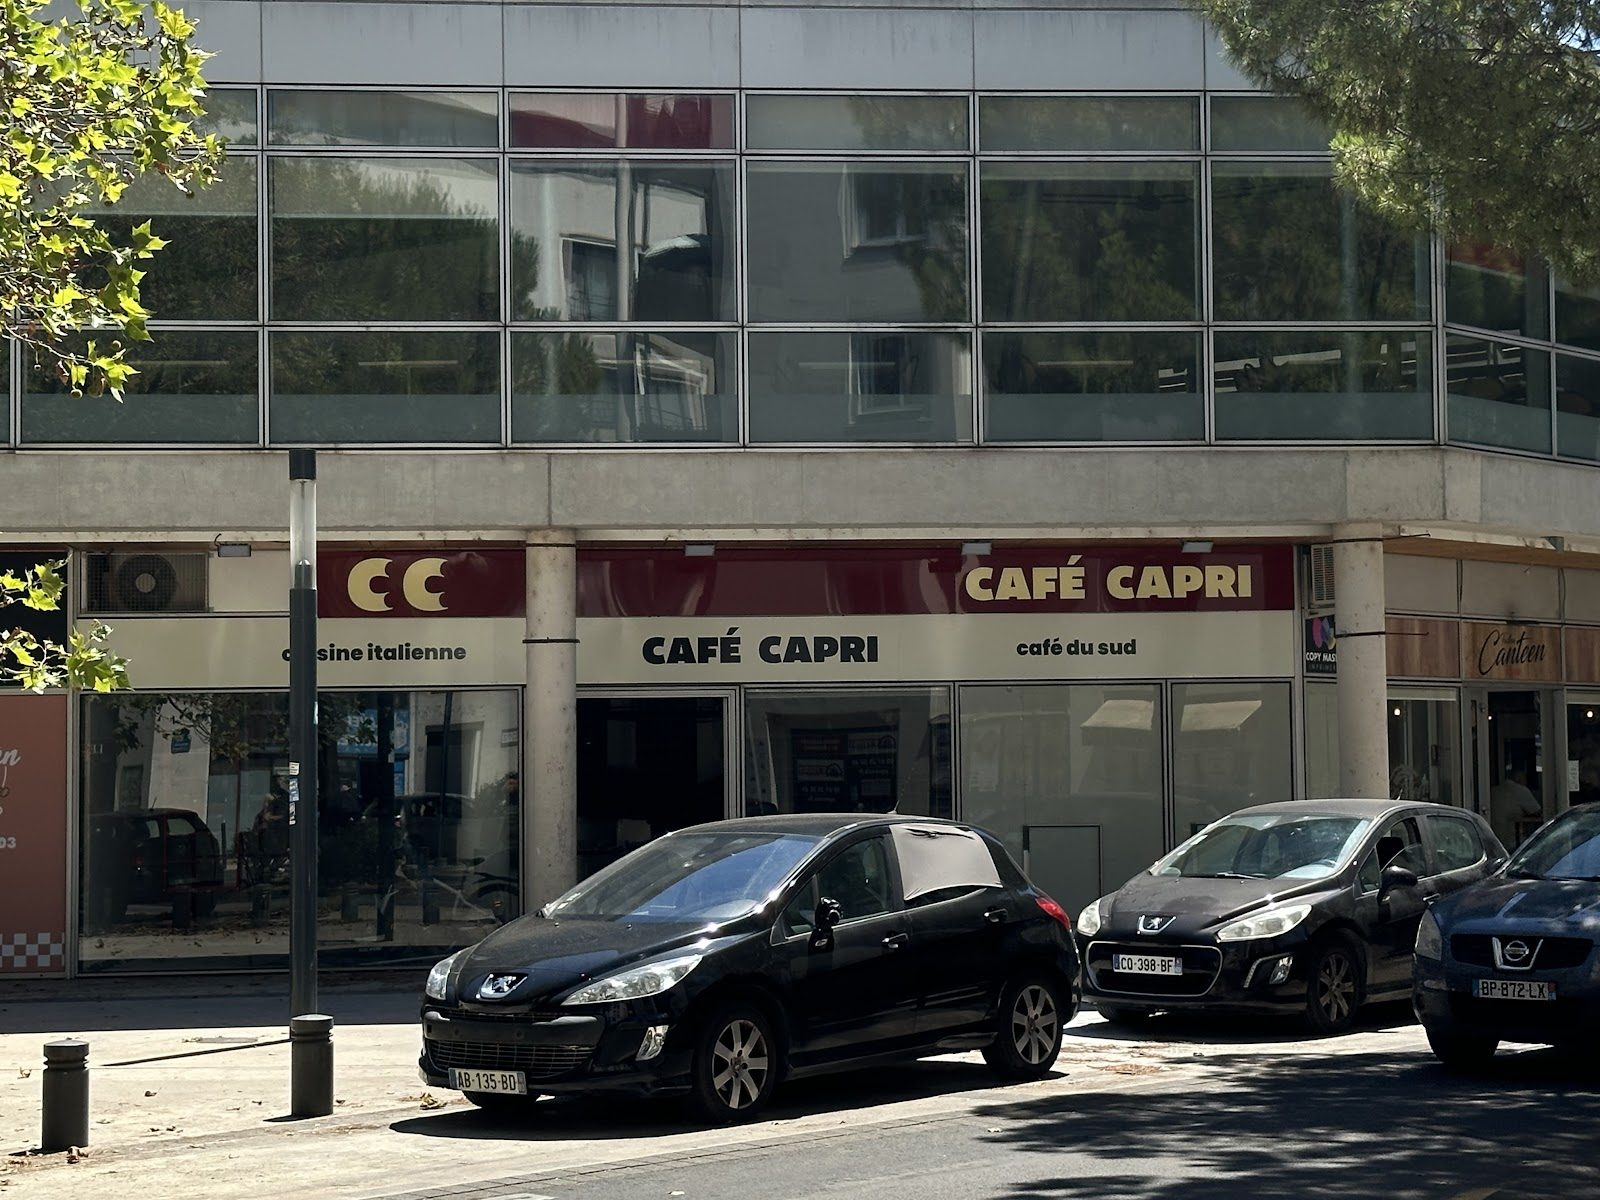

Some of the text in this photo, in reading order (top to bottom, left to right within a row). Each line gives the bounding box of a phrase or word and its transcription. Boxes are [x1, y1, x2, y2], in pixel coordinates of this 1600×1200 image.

[346, 556, 449, 613] CC
[965, 554, 1252, 601] CAFÉ CAPRI
[281, 642, 467, 662] csine italienne
[642, 626, 879, 665] CAFÉ CAPRI
[1016, 637, 1137, 656] café du sud
[1305, 652, 1336, 662] COPY MAS
[1478, 628, 1545, 676] Canteen
[457, 1071, 516, 1091] AB-135-BD
